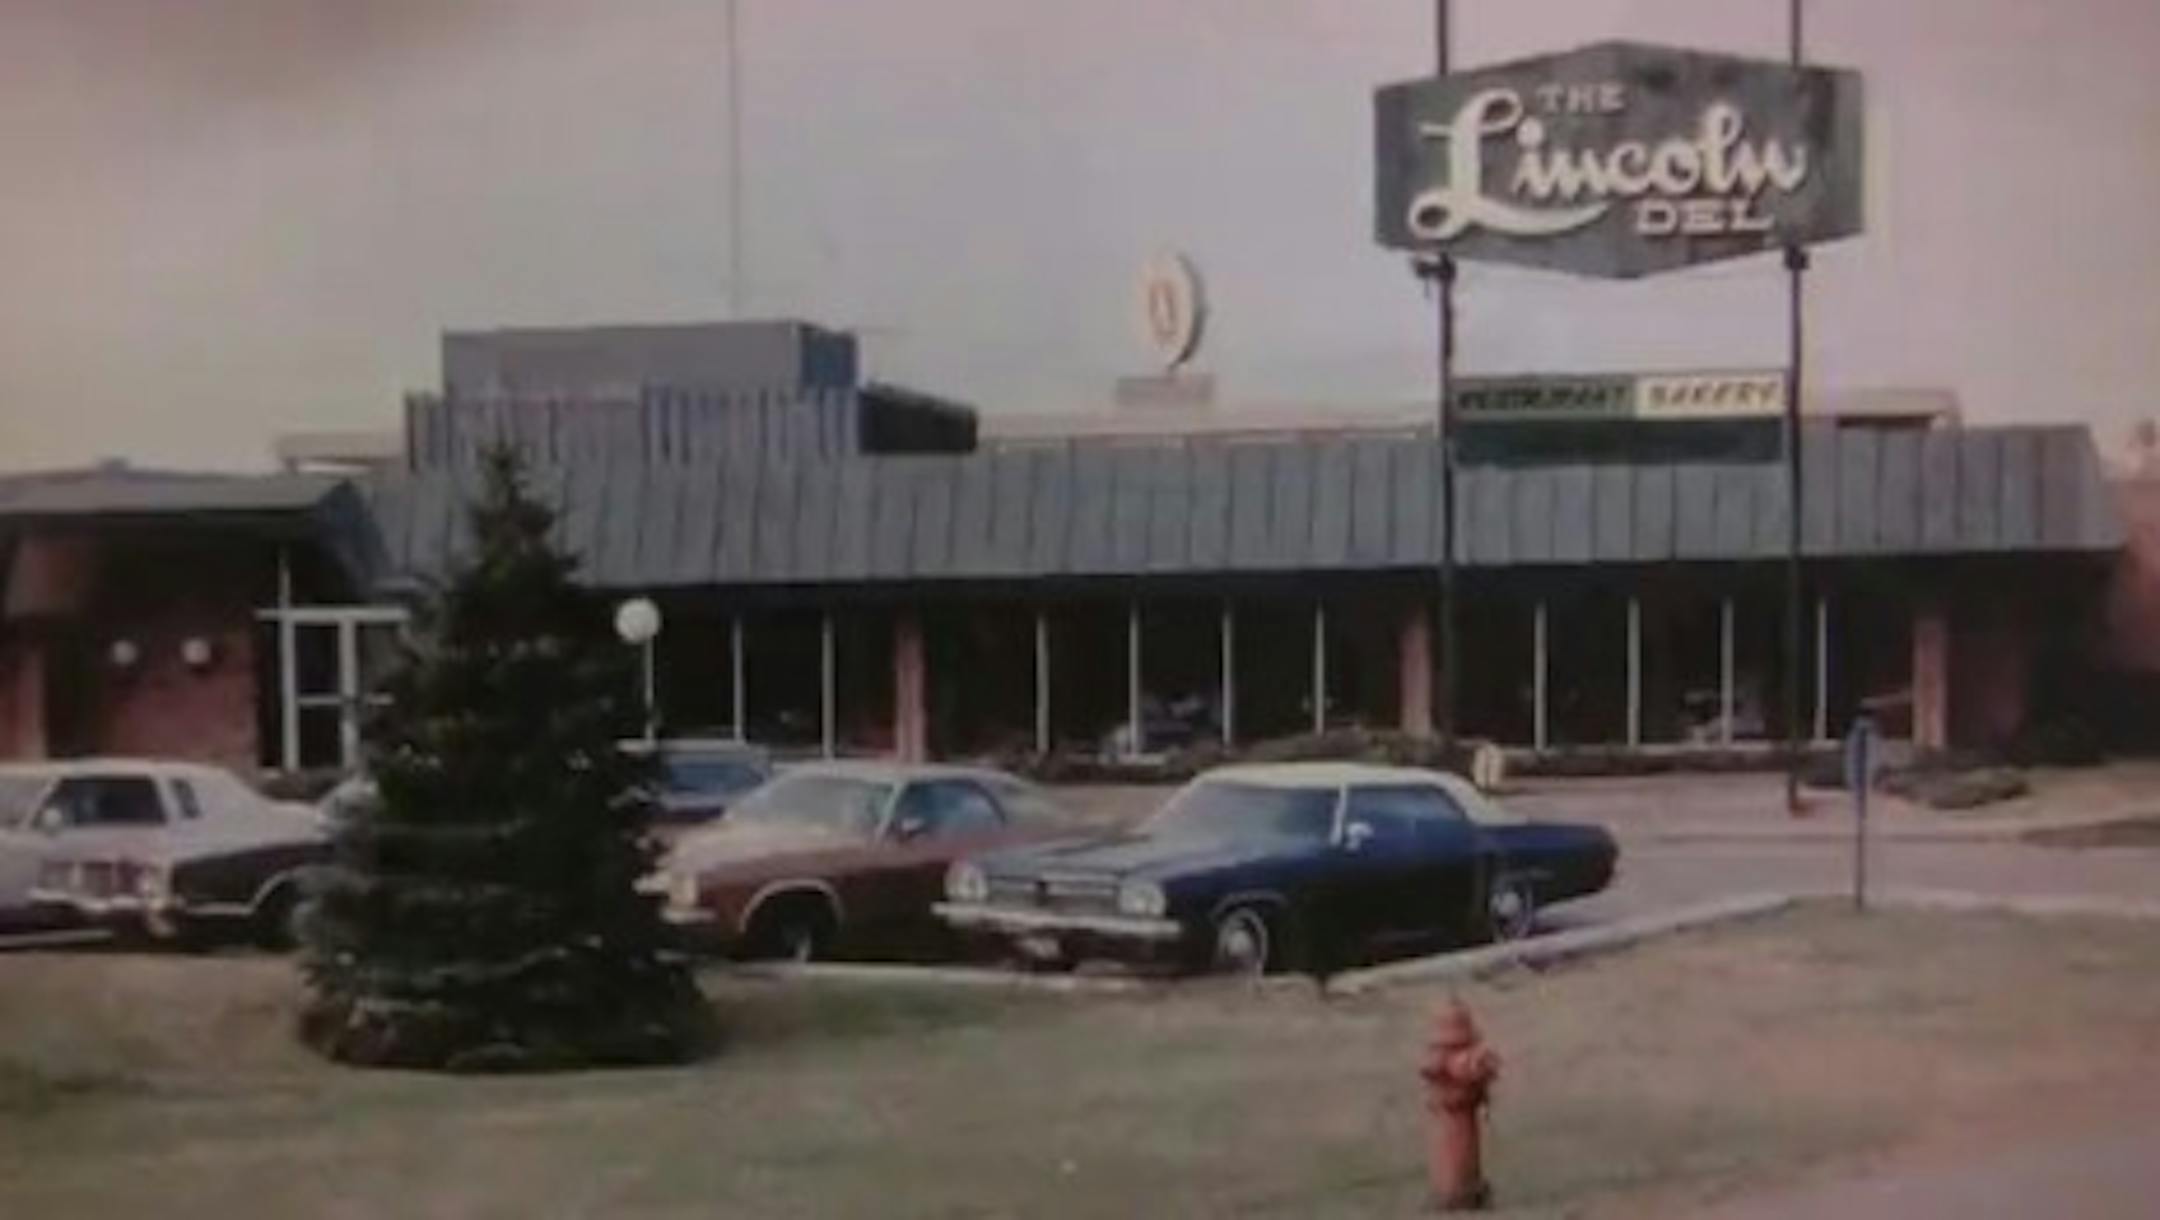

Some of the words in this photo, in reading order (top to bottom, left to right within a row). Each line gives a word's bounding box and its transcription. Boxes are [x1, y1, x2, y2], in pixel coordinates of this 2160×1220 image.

[1536, 83, 1627, 114] THE
[1409, 87, 1807, 240] Lincoln
[1636, 198, 1775, 234] DEL
